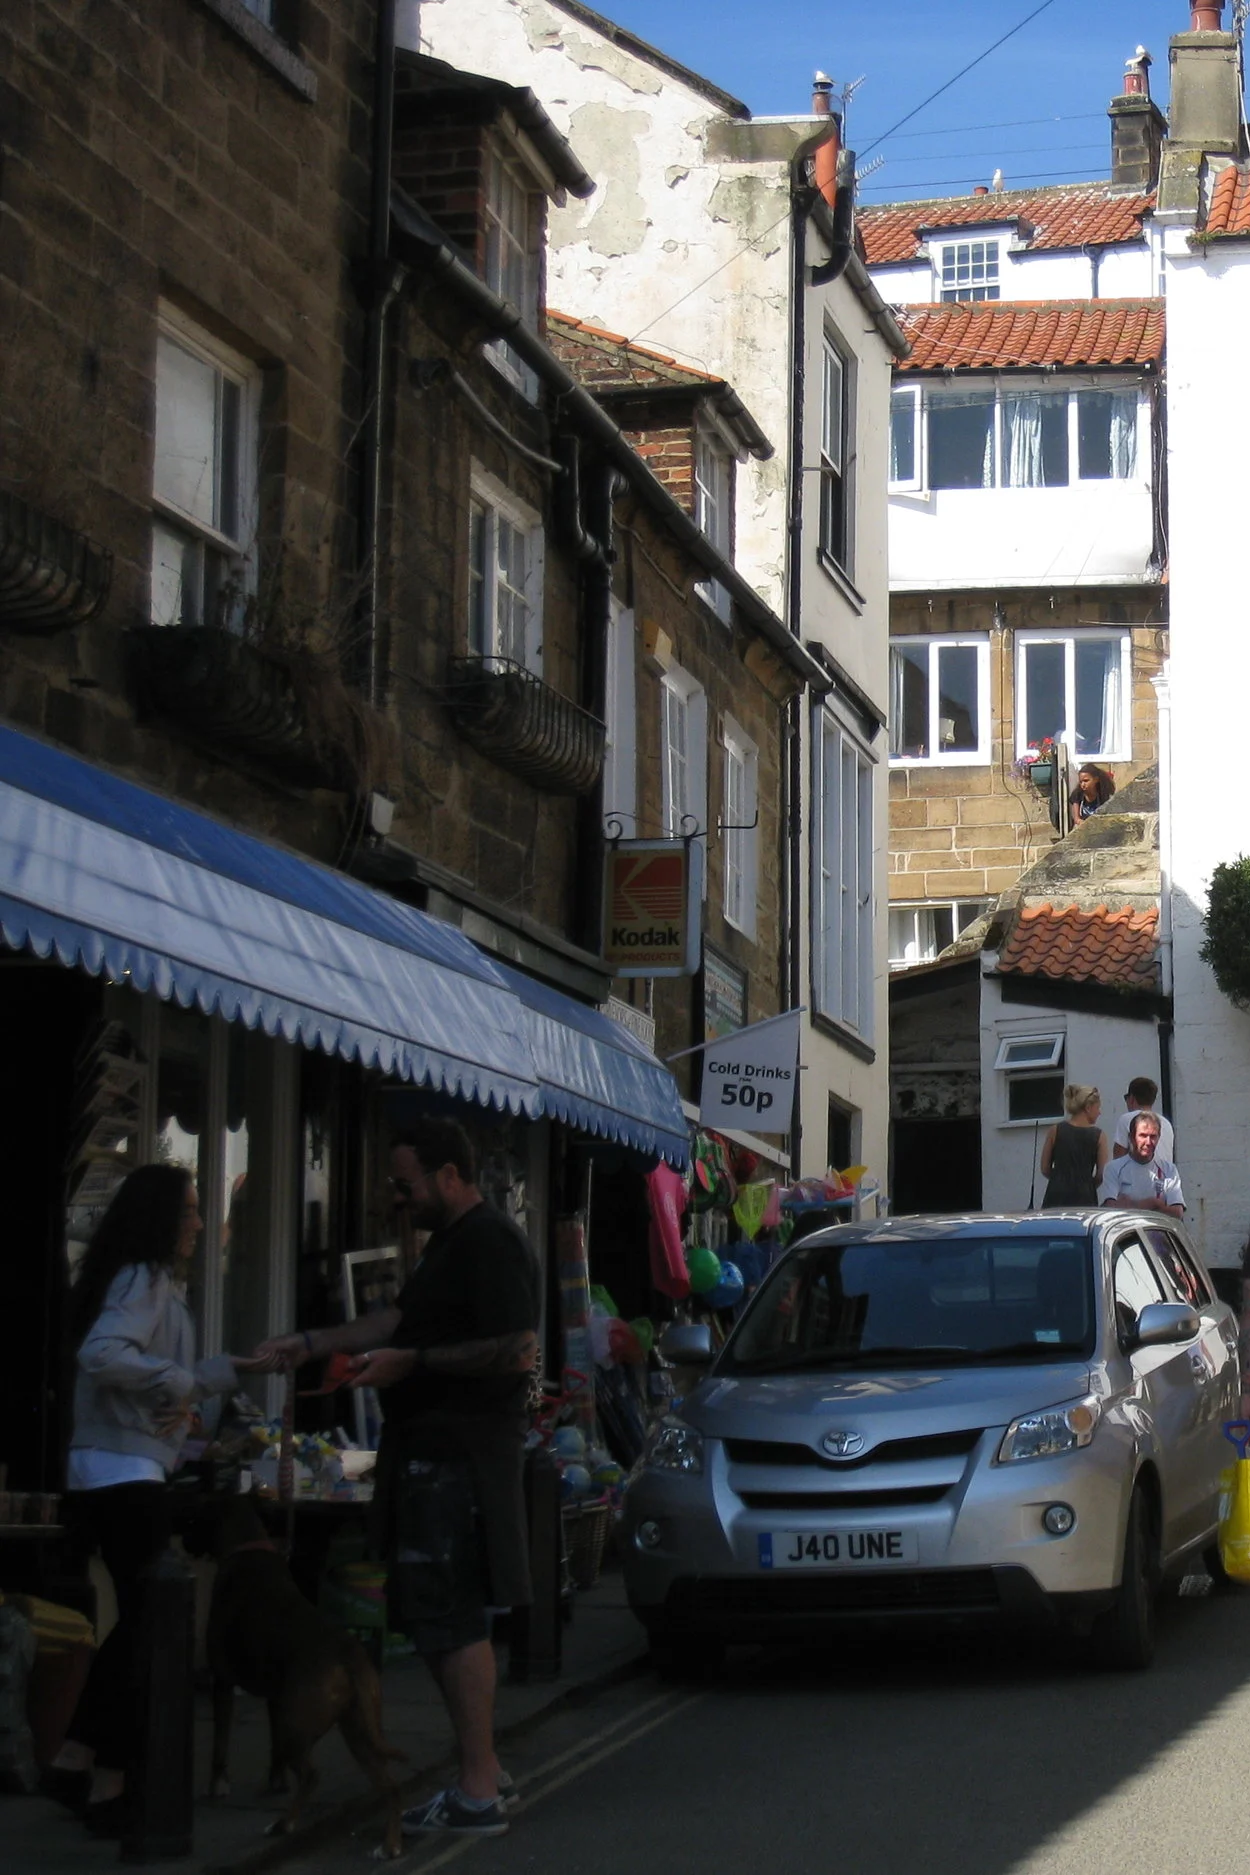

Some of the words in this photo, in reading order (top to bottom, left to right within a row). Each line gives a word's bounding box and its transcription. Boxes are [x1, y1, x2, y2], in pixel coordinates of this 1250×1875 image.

[611, 927, 680, 946] Kodak
[708, 1061, 740, 1075] Cold
[745, 1064, 791, 1080] Drinks
[721, 1083, 773, 1114] 50p
[787, 1534, 839, 1561] J40
[848, 1532, 903, 1560] UNE
